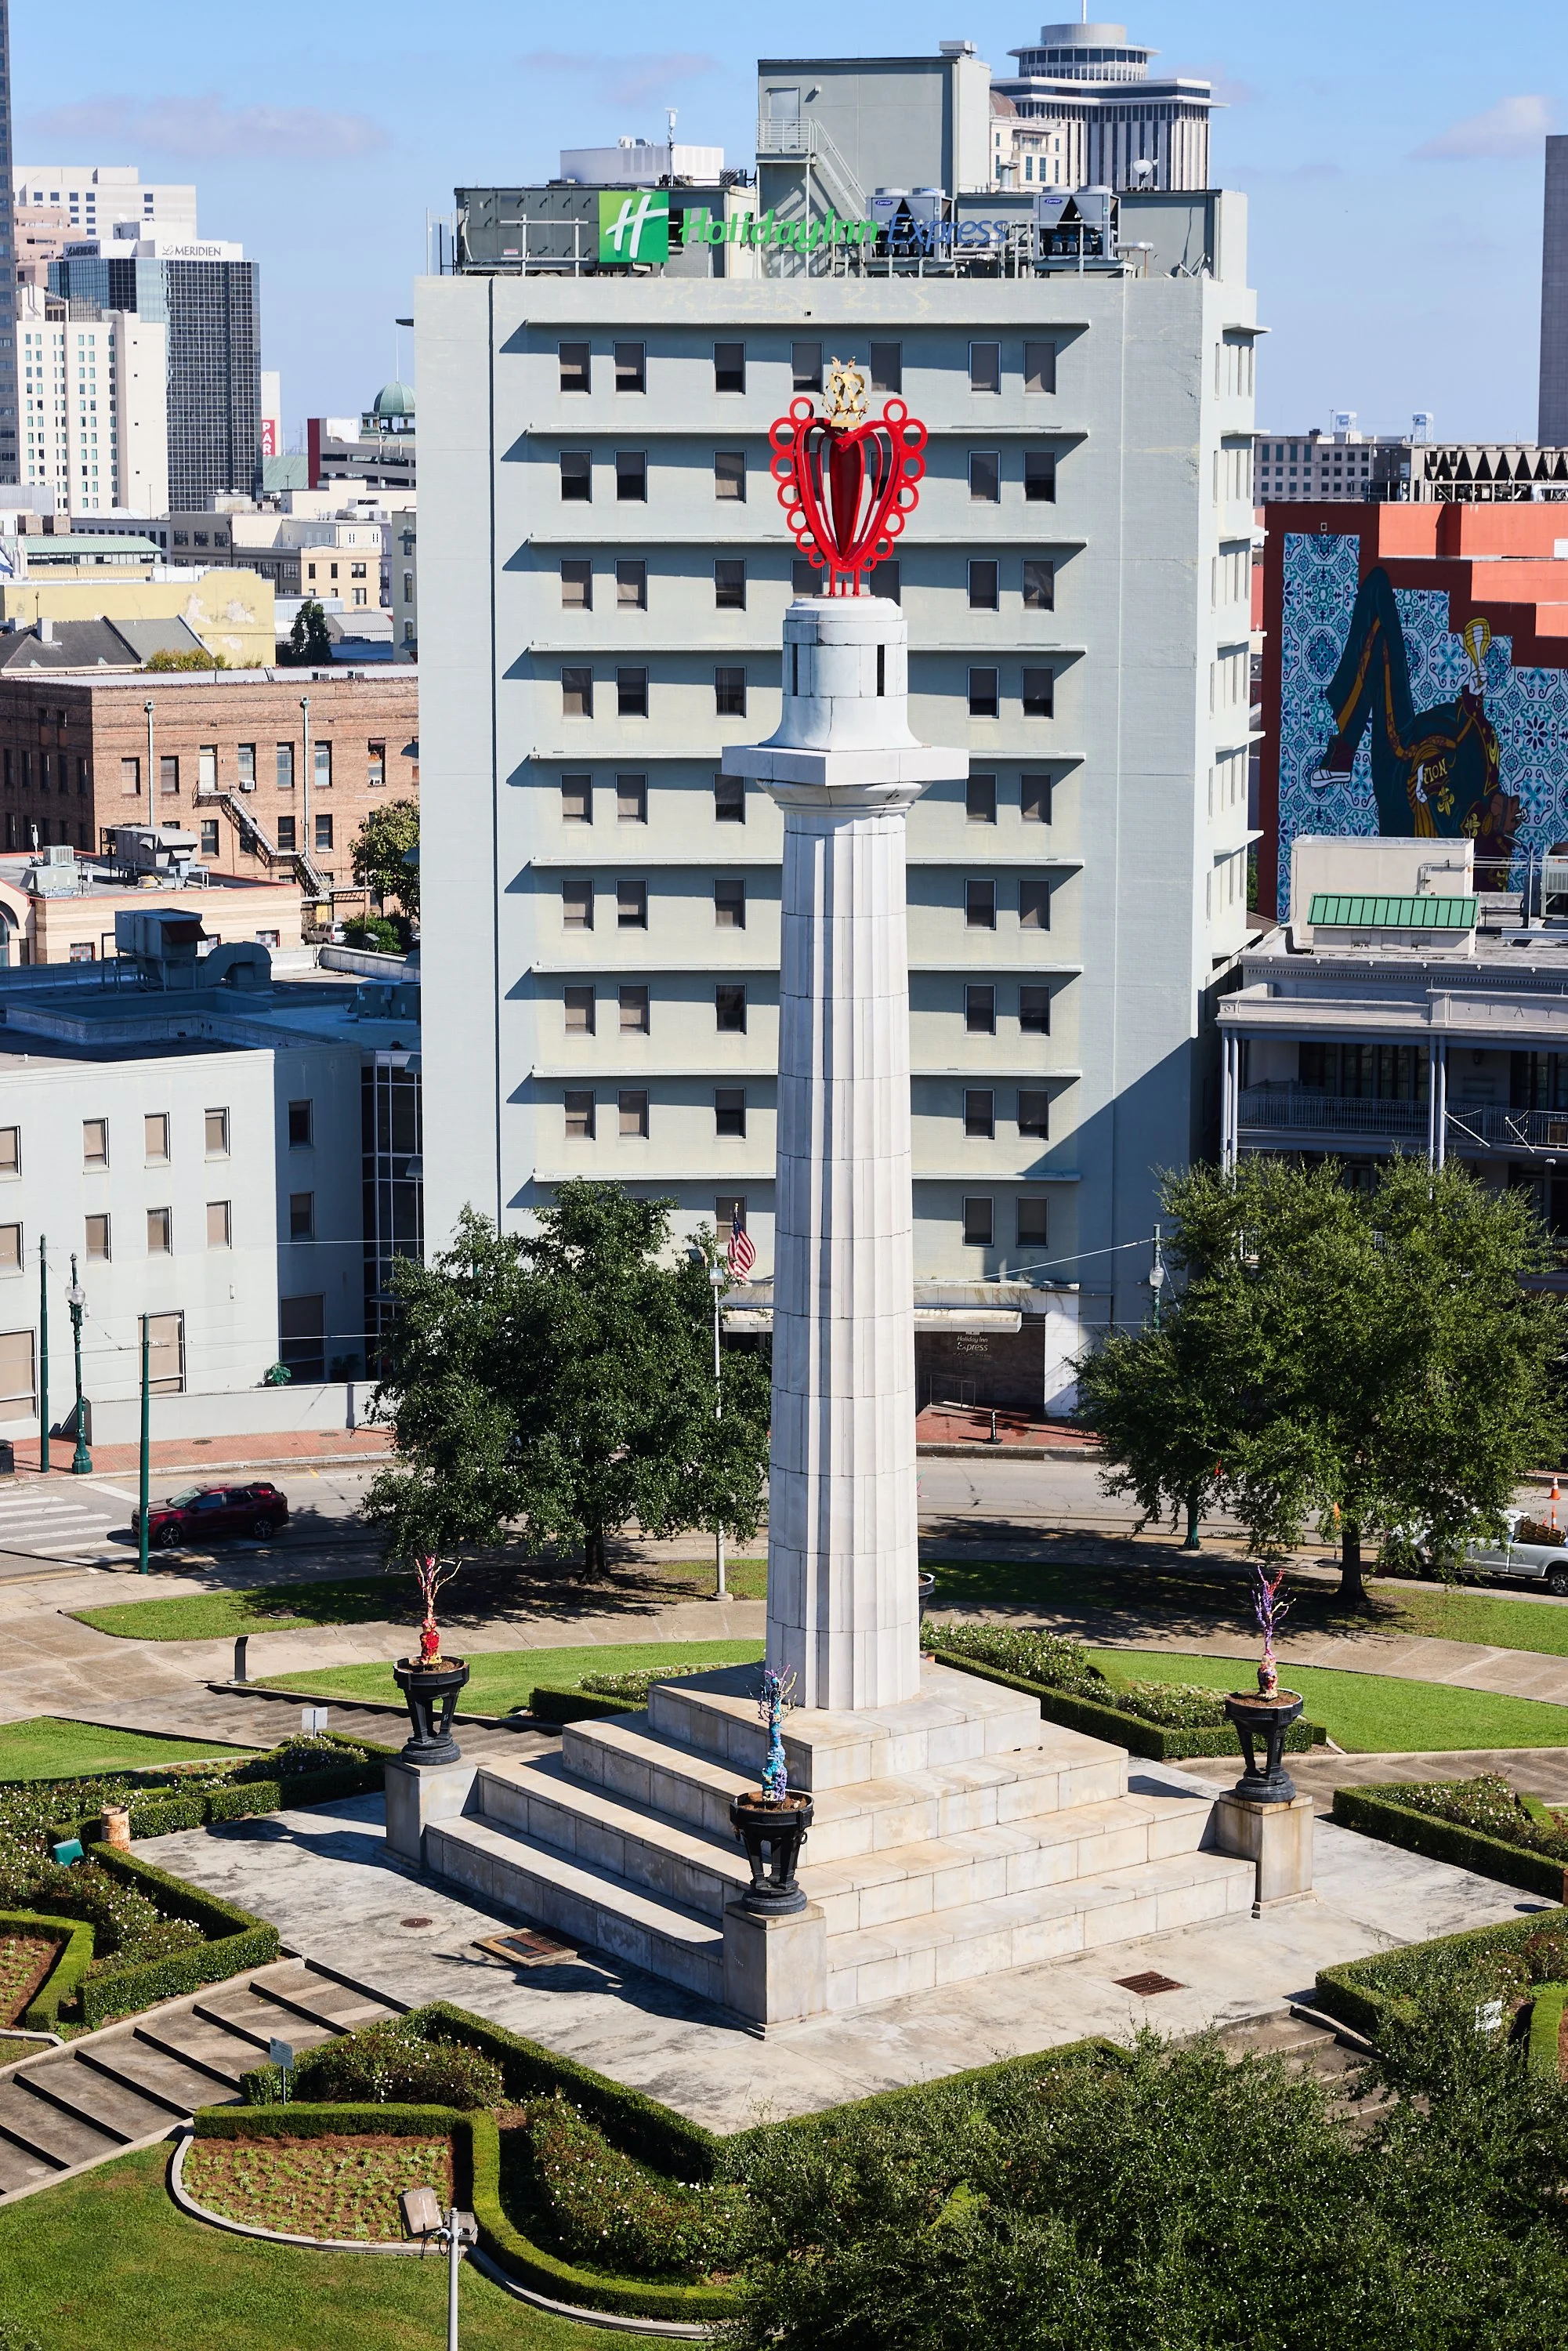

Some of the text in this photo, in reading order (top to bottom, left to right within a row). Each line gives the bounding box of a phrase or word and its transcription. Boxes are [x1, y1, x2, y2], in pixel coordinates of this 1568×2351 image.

[679, 207, 1009, 253] Holiday Inn Express
[175, 245, 221, 256] MERIDIEN
[263, 422, 272, 456] PAR
